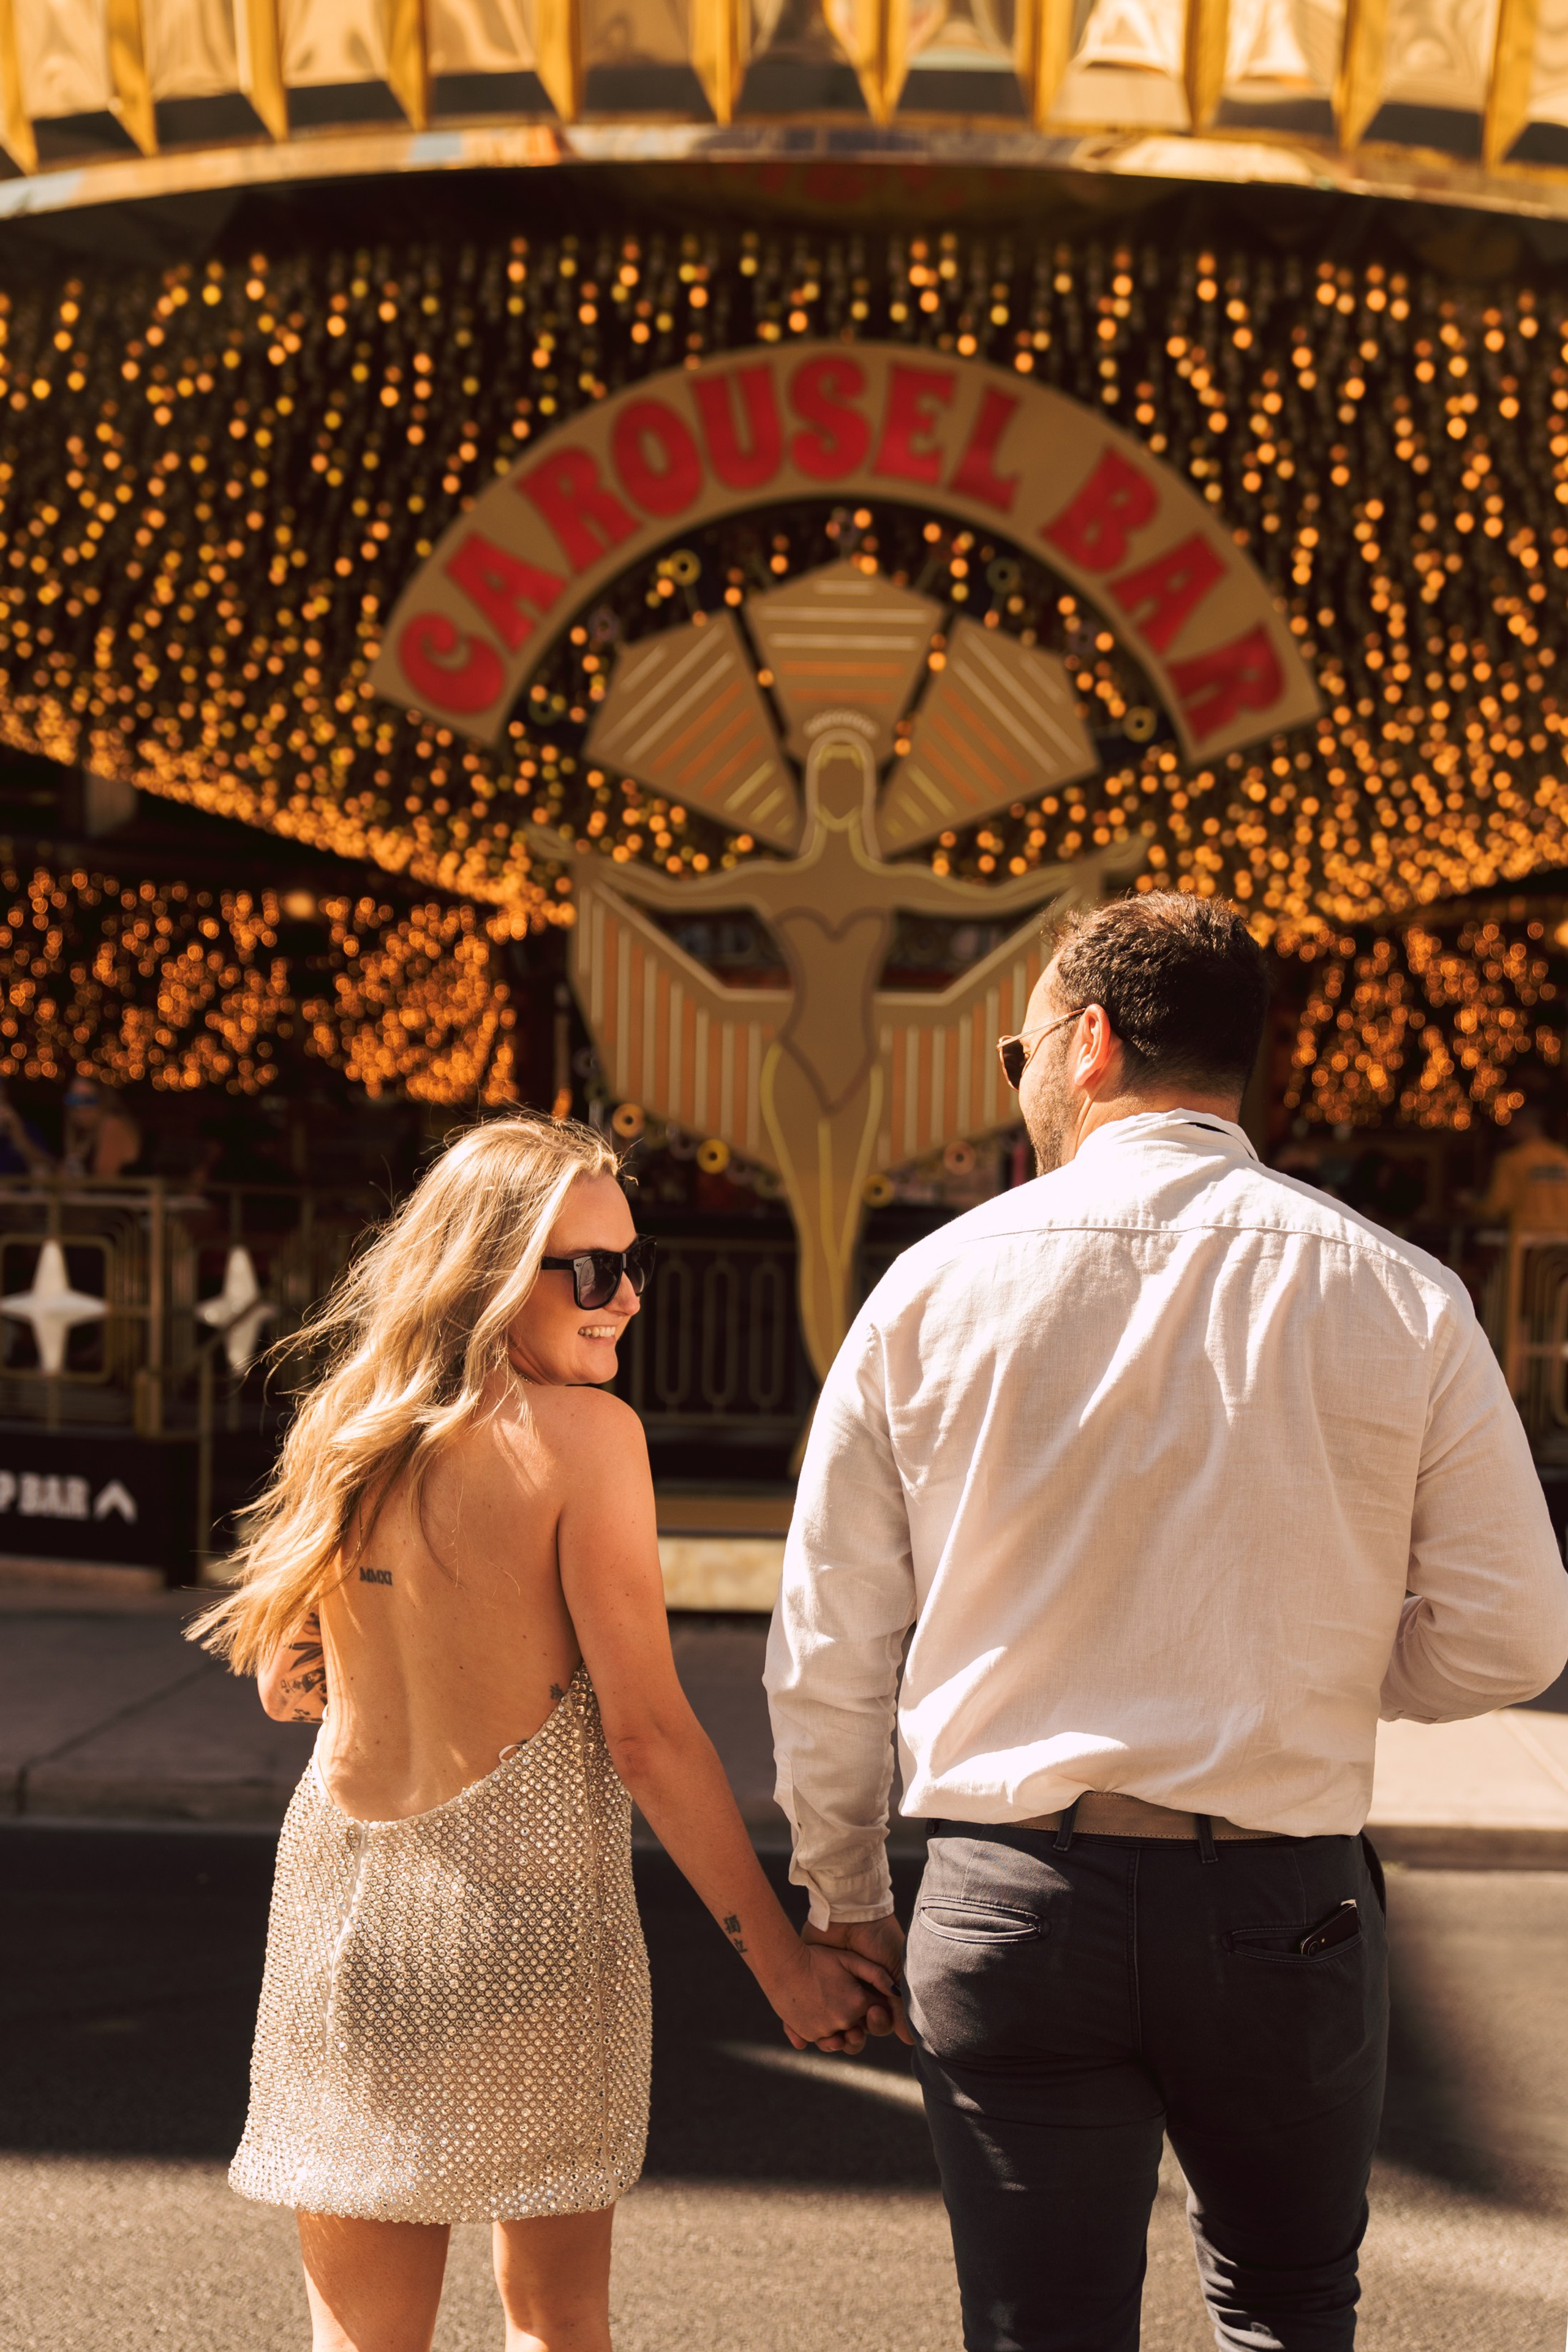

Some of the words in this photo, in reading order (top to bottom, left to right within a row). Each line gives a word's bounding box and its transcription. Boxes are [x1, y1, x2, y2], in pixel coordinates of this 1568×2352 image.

[398, 353, 1022, 715] CAROUSEL
[1038, 443, 1287, 746] BAR
[20, 1472, 89, 1518] BAR
